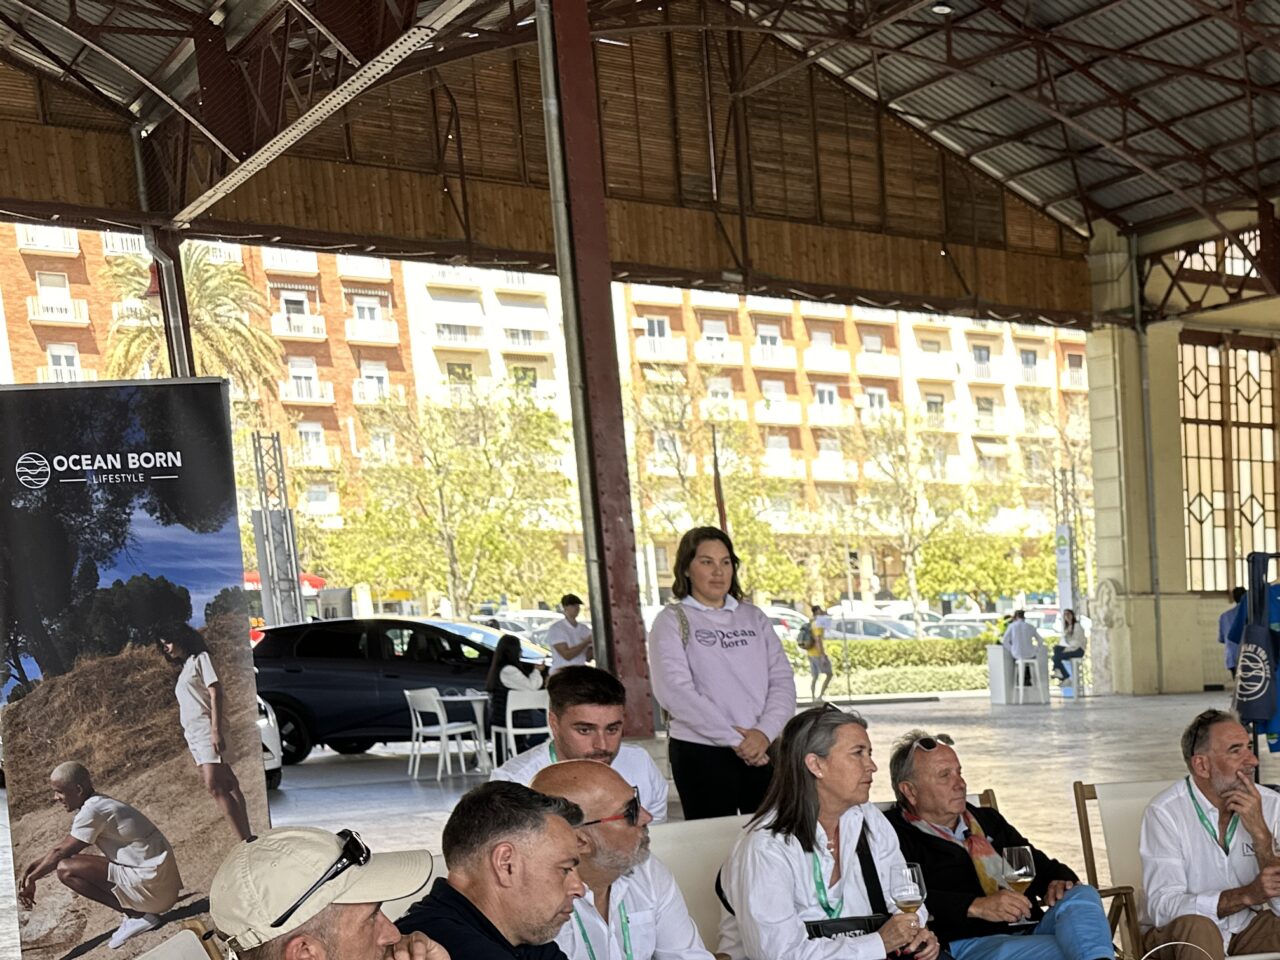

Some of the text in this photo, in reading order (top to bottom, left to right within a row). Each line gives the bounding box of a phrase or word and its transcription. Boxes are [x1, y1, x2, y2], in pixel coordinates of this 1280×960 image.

[53, 451, 183, 472] OCEAN BORN
[92, 473, 145, 484] LIFESTYLE
[715, 629, 756, 639] Ocean
[720, 638, 748, 649] Born
